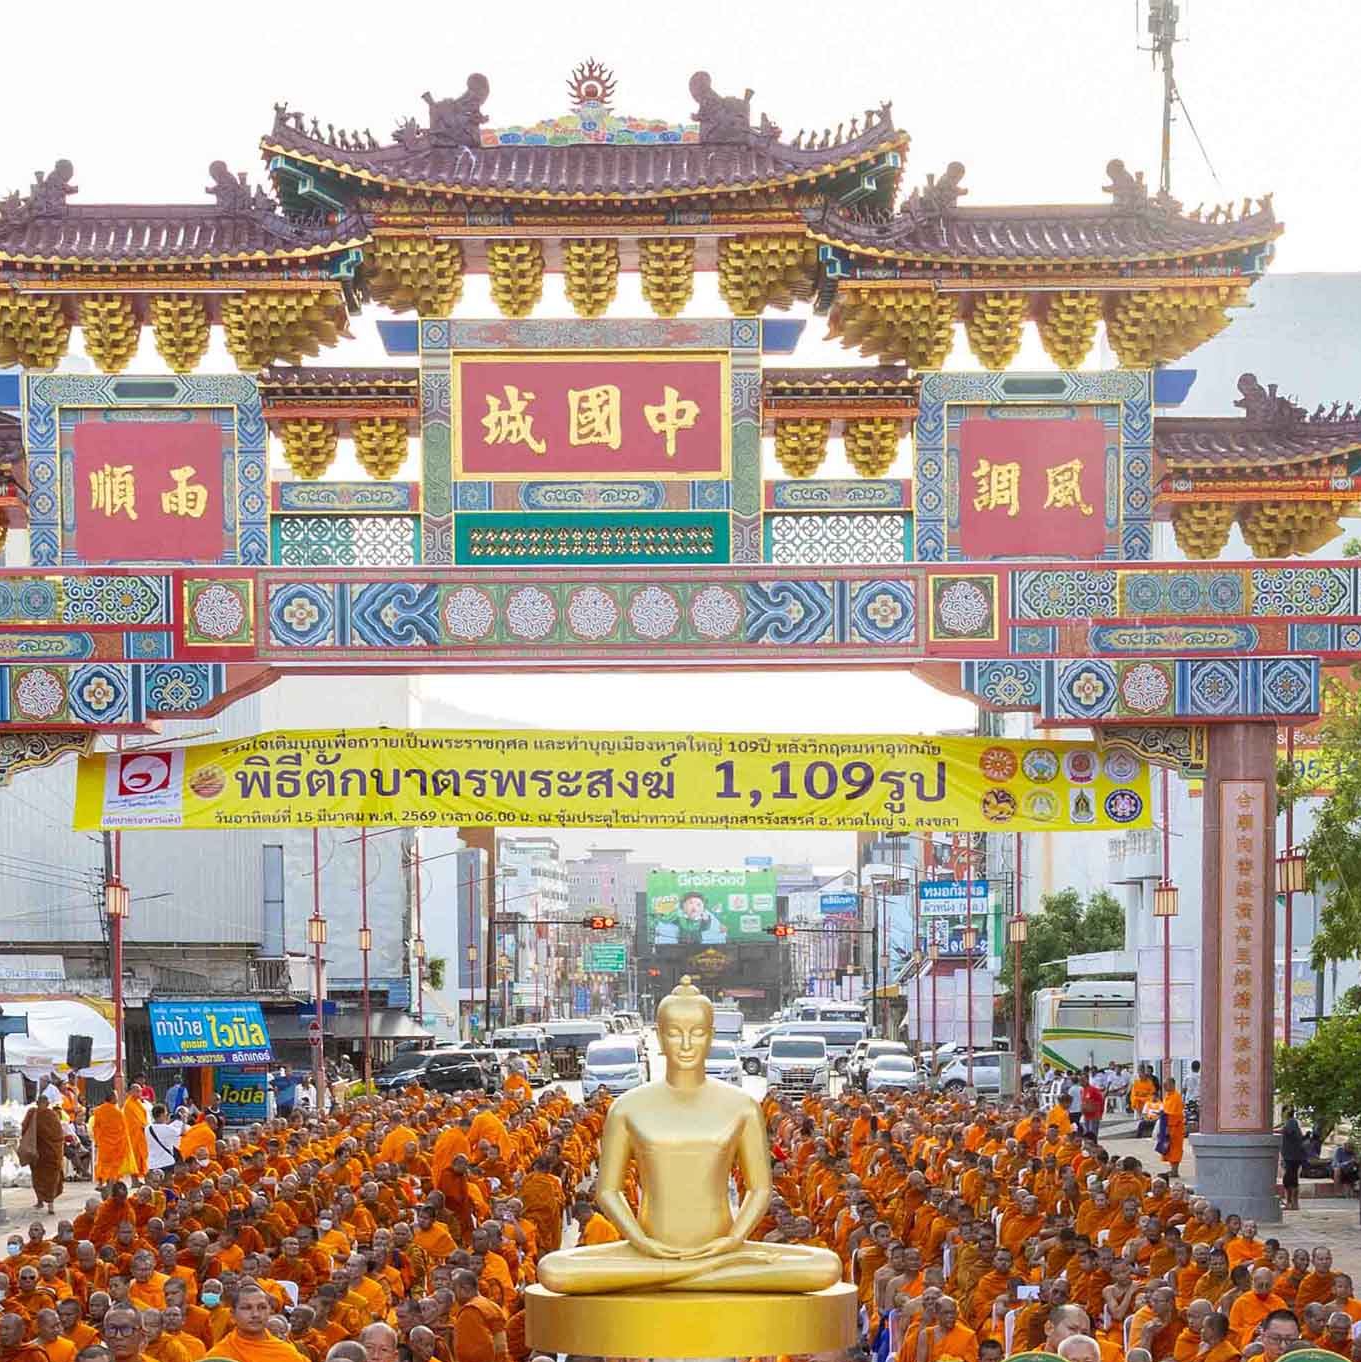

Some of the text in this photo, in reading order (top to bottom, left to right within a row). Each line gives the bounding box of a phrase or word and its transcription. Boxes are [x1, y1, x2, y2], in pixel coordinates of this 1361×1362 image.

[234, 750, 679, 799] พิธีตักบาตรพระสงฆ์
[297, 811, 313, 822] 15
[402, 811, 436, 822] 2569
[476, 812, 516, 823] 06.00
